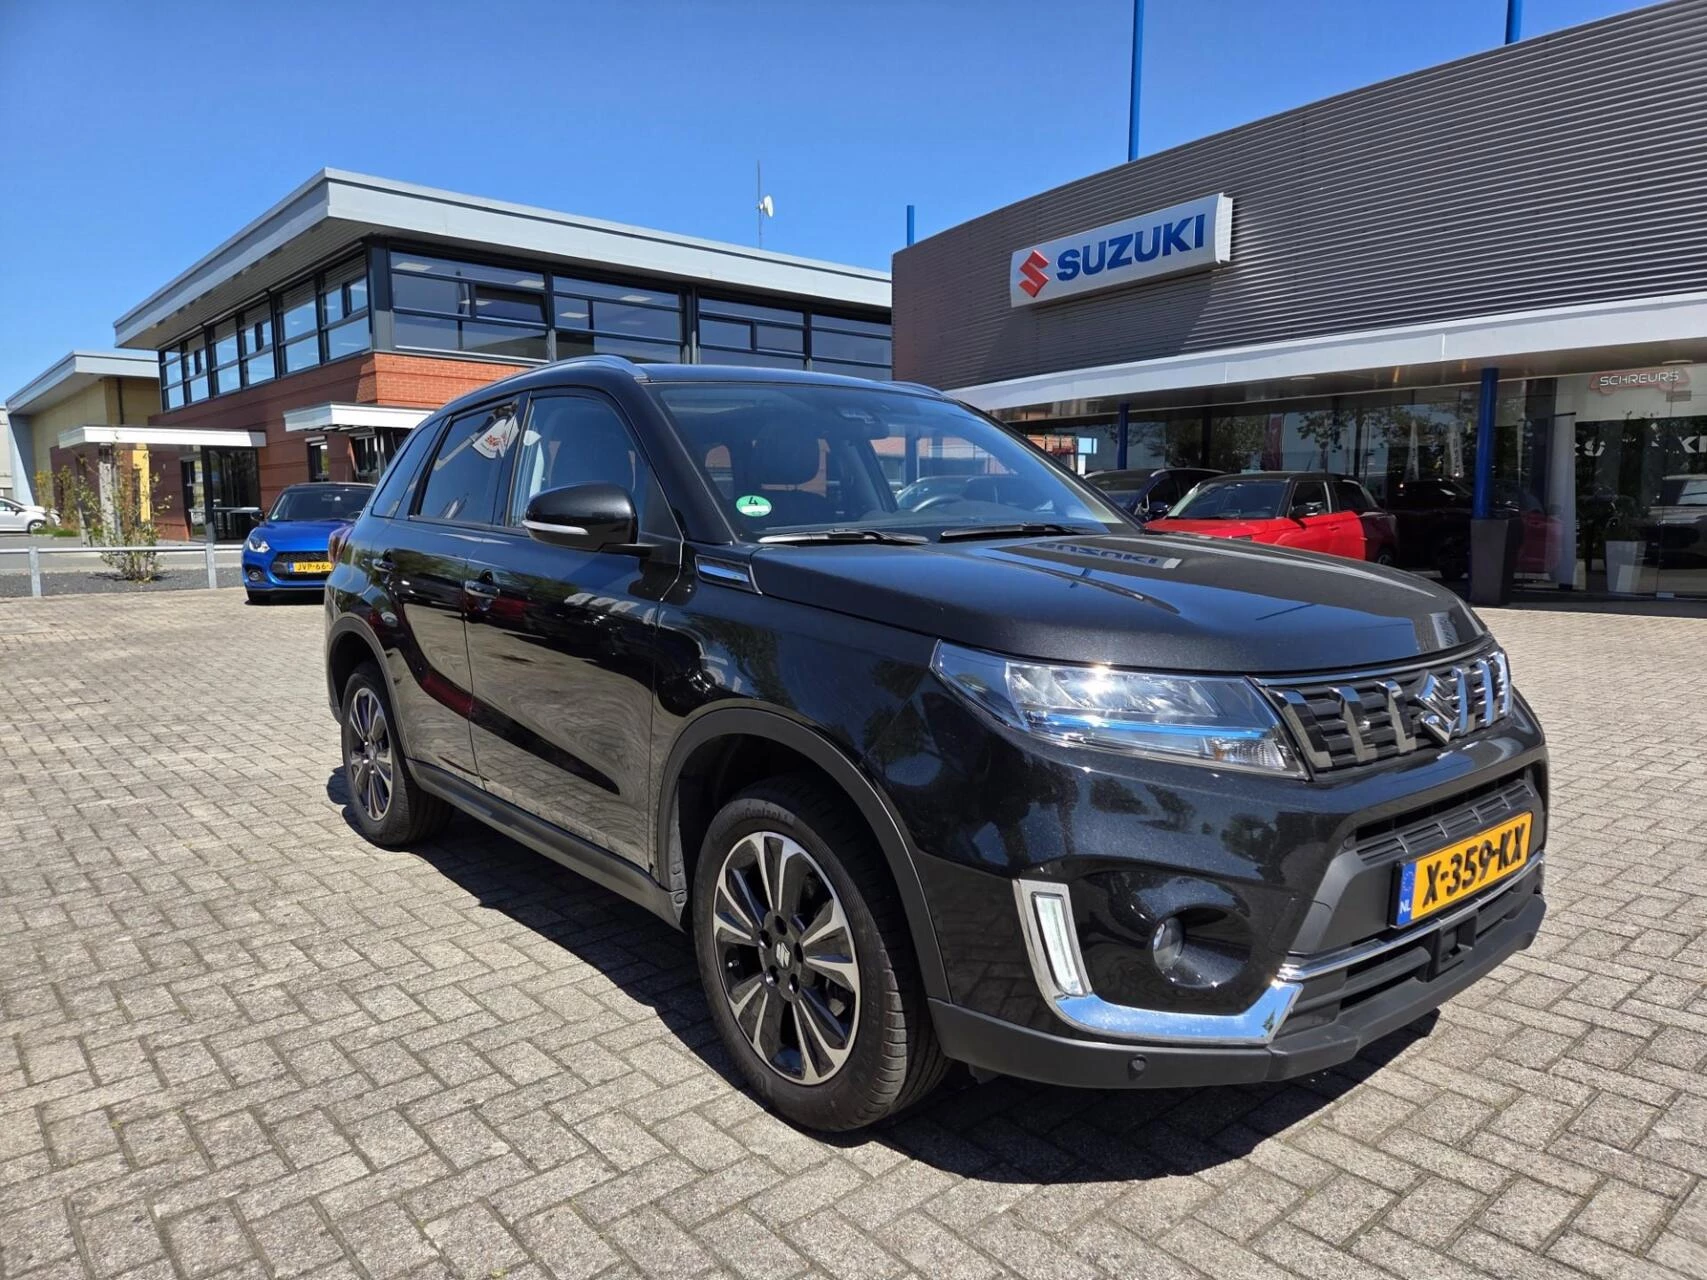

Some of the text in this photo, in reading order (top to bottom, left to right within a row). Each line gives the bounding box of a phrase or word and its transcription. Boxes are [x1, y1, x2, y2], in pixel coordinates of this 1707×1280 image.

[1056, 214, 1205, 281] SUZUKI
[1600, 370, 1679, 386] SCHREURS
[748, 496, 759, 506] 4
[1422, 823, 1526, 909] X-359-KX
[1399, 899, 1412, 914] NL
